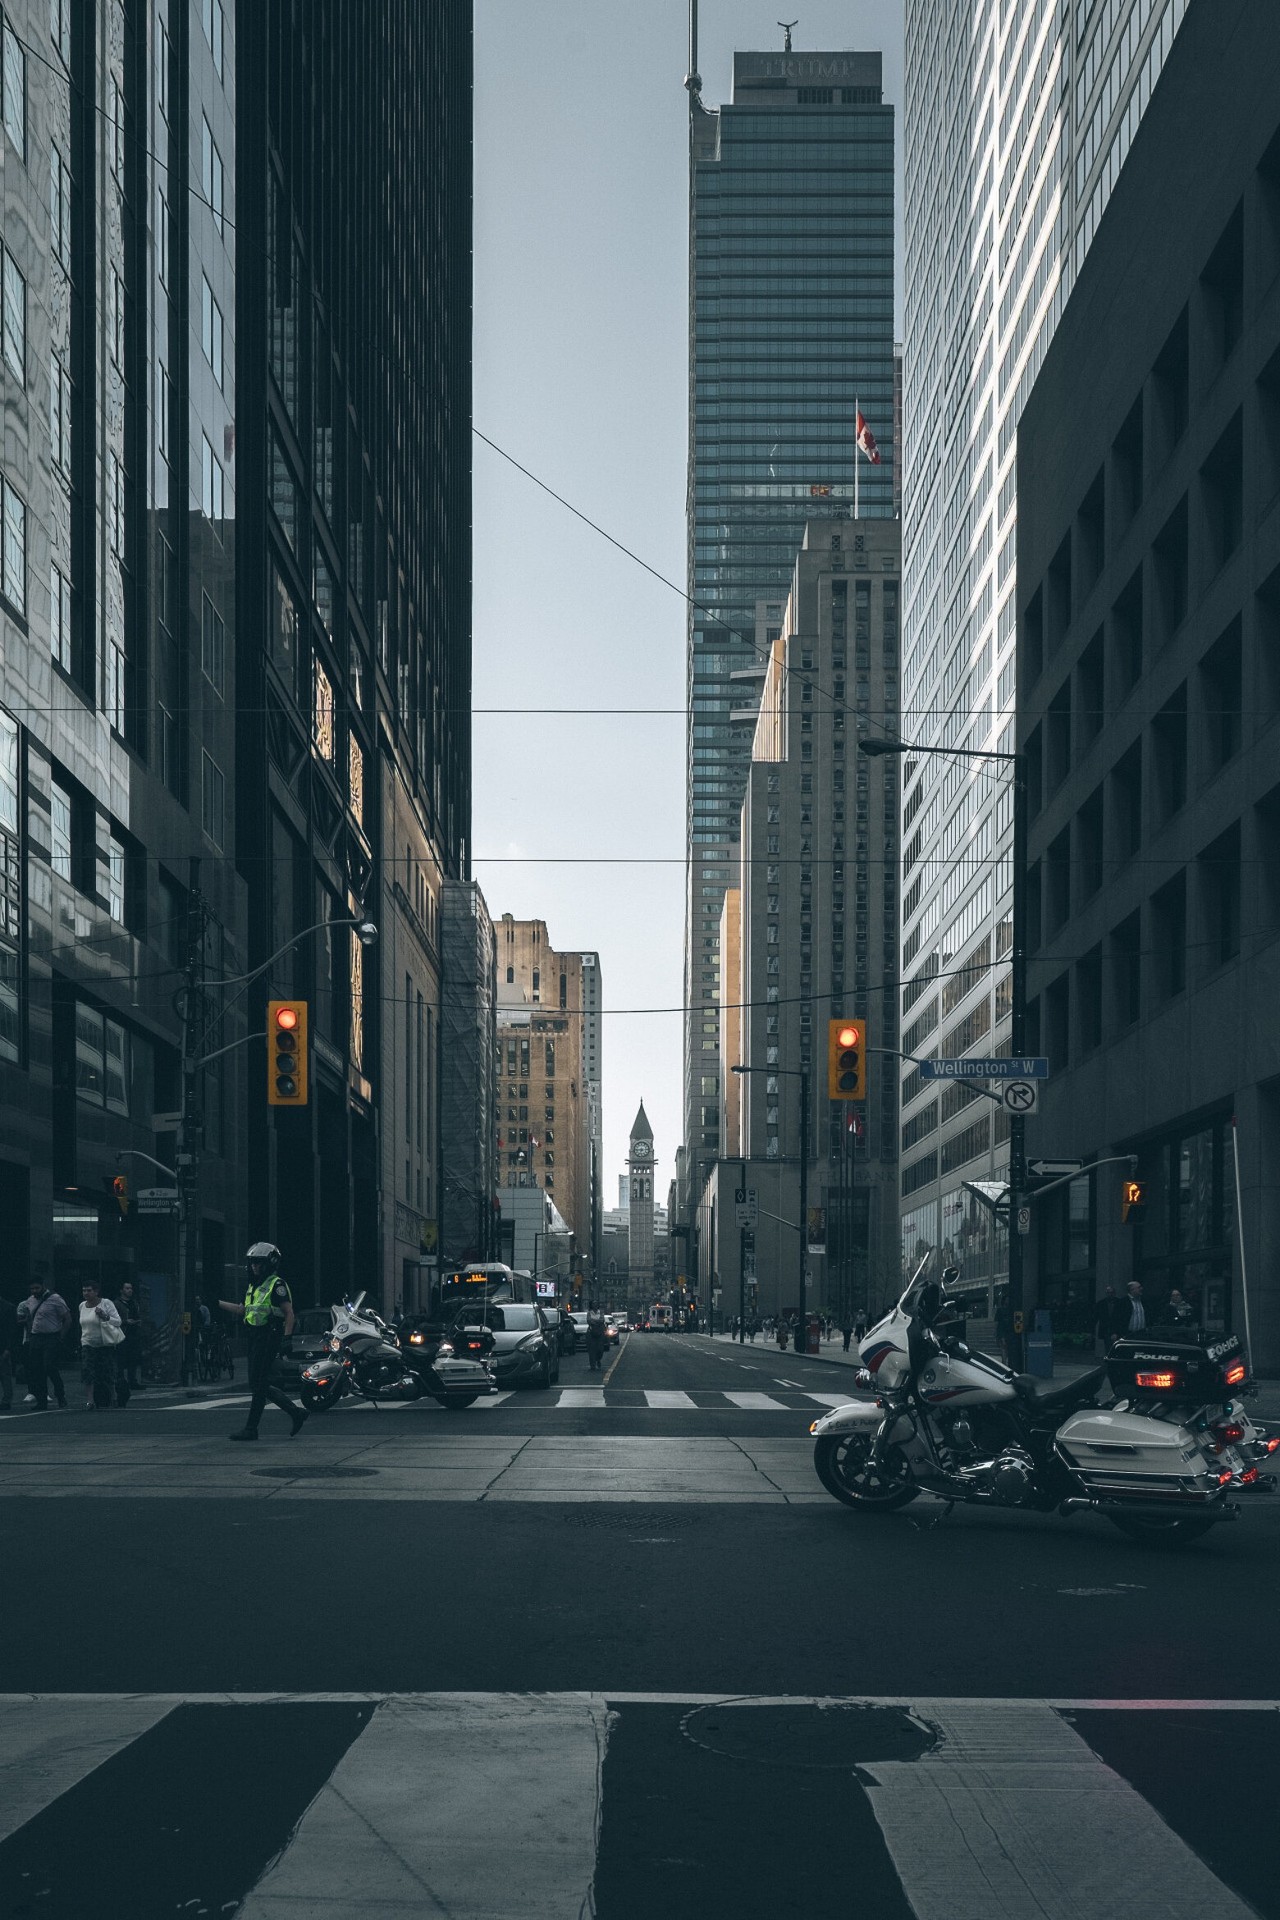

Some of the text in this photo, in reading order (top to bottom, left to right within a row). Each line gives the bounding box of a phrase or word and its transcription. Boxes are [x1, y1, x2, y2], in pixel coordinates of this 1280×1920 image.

[760, 58, 855, 78] TRUMP
[933, 1061, 1007, 1079] Wellington
[1023, 1061, 1034, 1074] W
[855, 1171, 896, 1182] BANK
[138, 1198, 170, 1208] Wellington
[1206, 1335, 1239, 1360] POLICE
